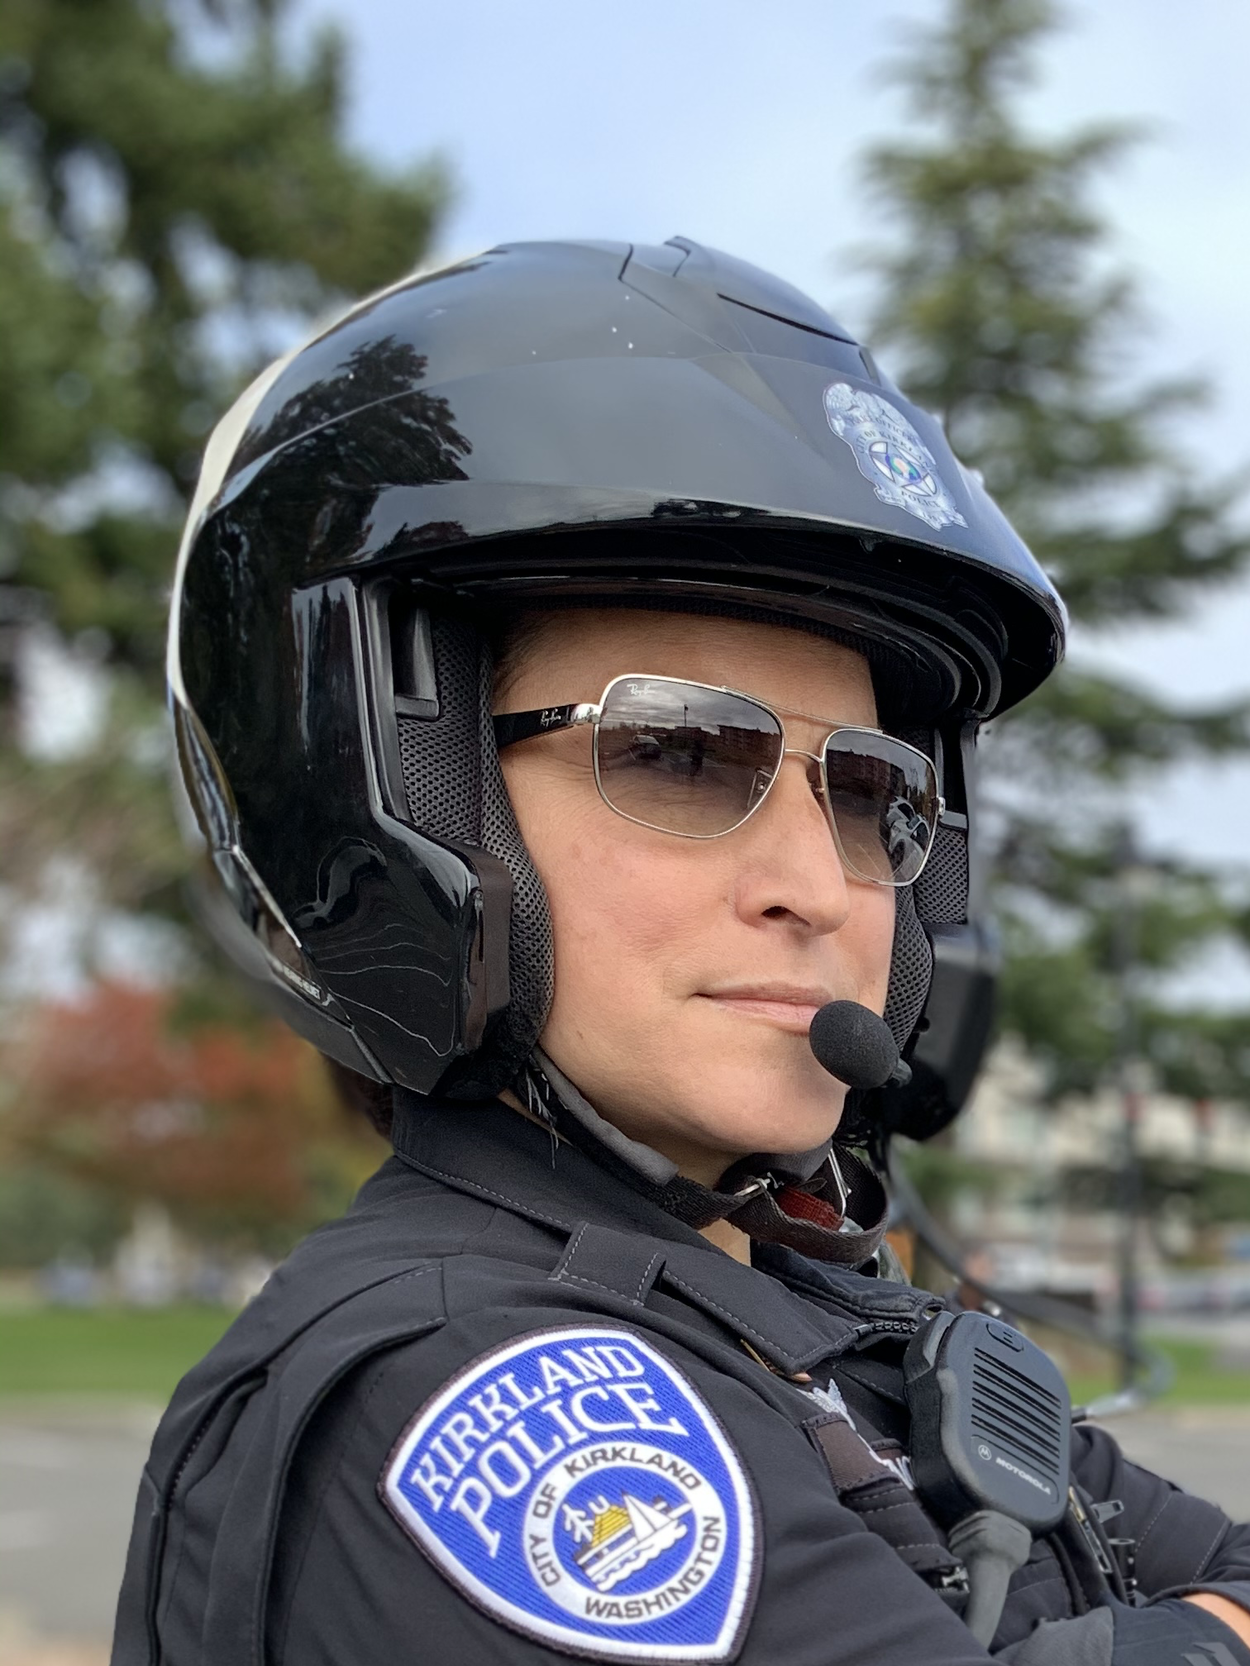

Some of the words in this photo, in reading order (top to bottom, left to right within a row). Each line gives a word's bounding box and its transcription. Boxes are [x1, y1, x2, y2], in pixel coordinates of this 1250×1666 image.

[410, 1345, 645, 1513] KIRKLAND
[449, 1383, 689, 1559] POLICE
[564, 1446, 701, 1491] KIRKLAND
[996, 1457, 1051, 1495] MOTOROLA
[533, 1482, 559, 1519] OF
[528, 1534, 561, 1588] CITY
[584, 1515, 721, 1619] WASHINGTON
